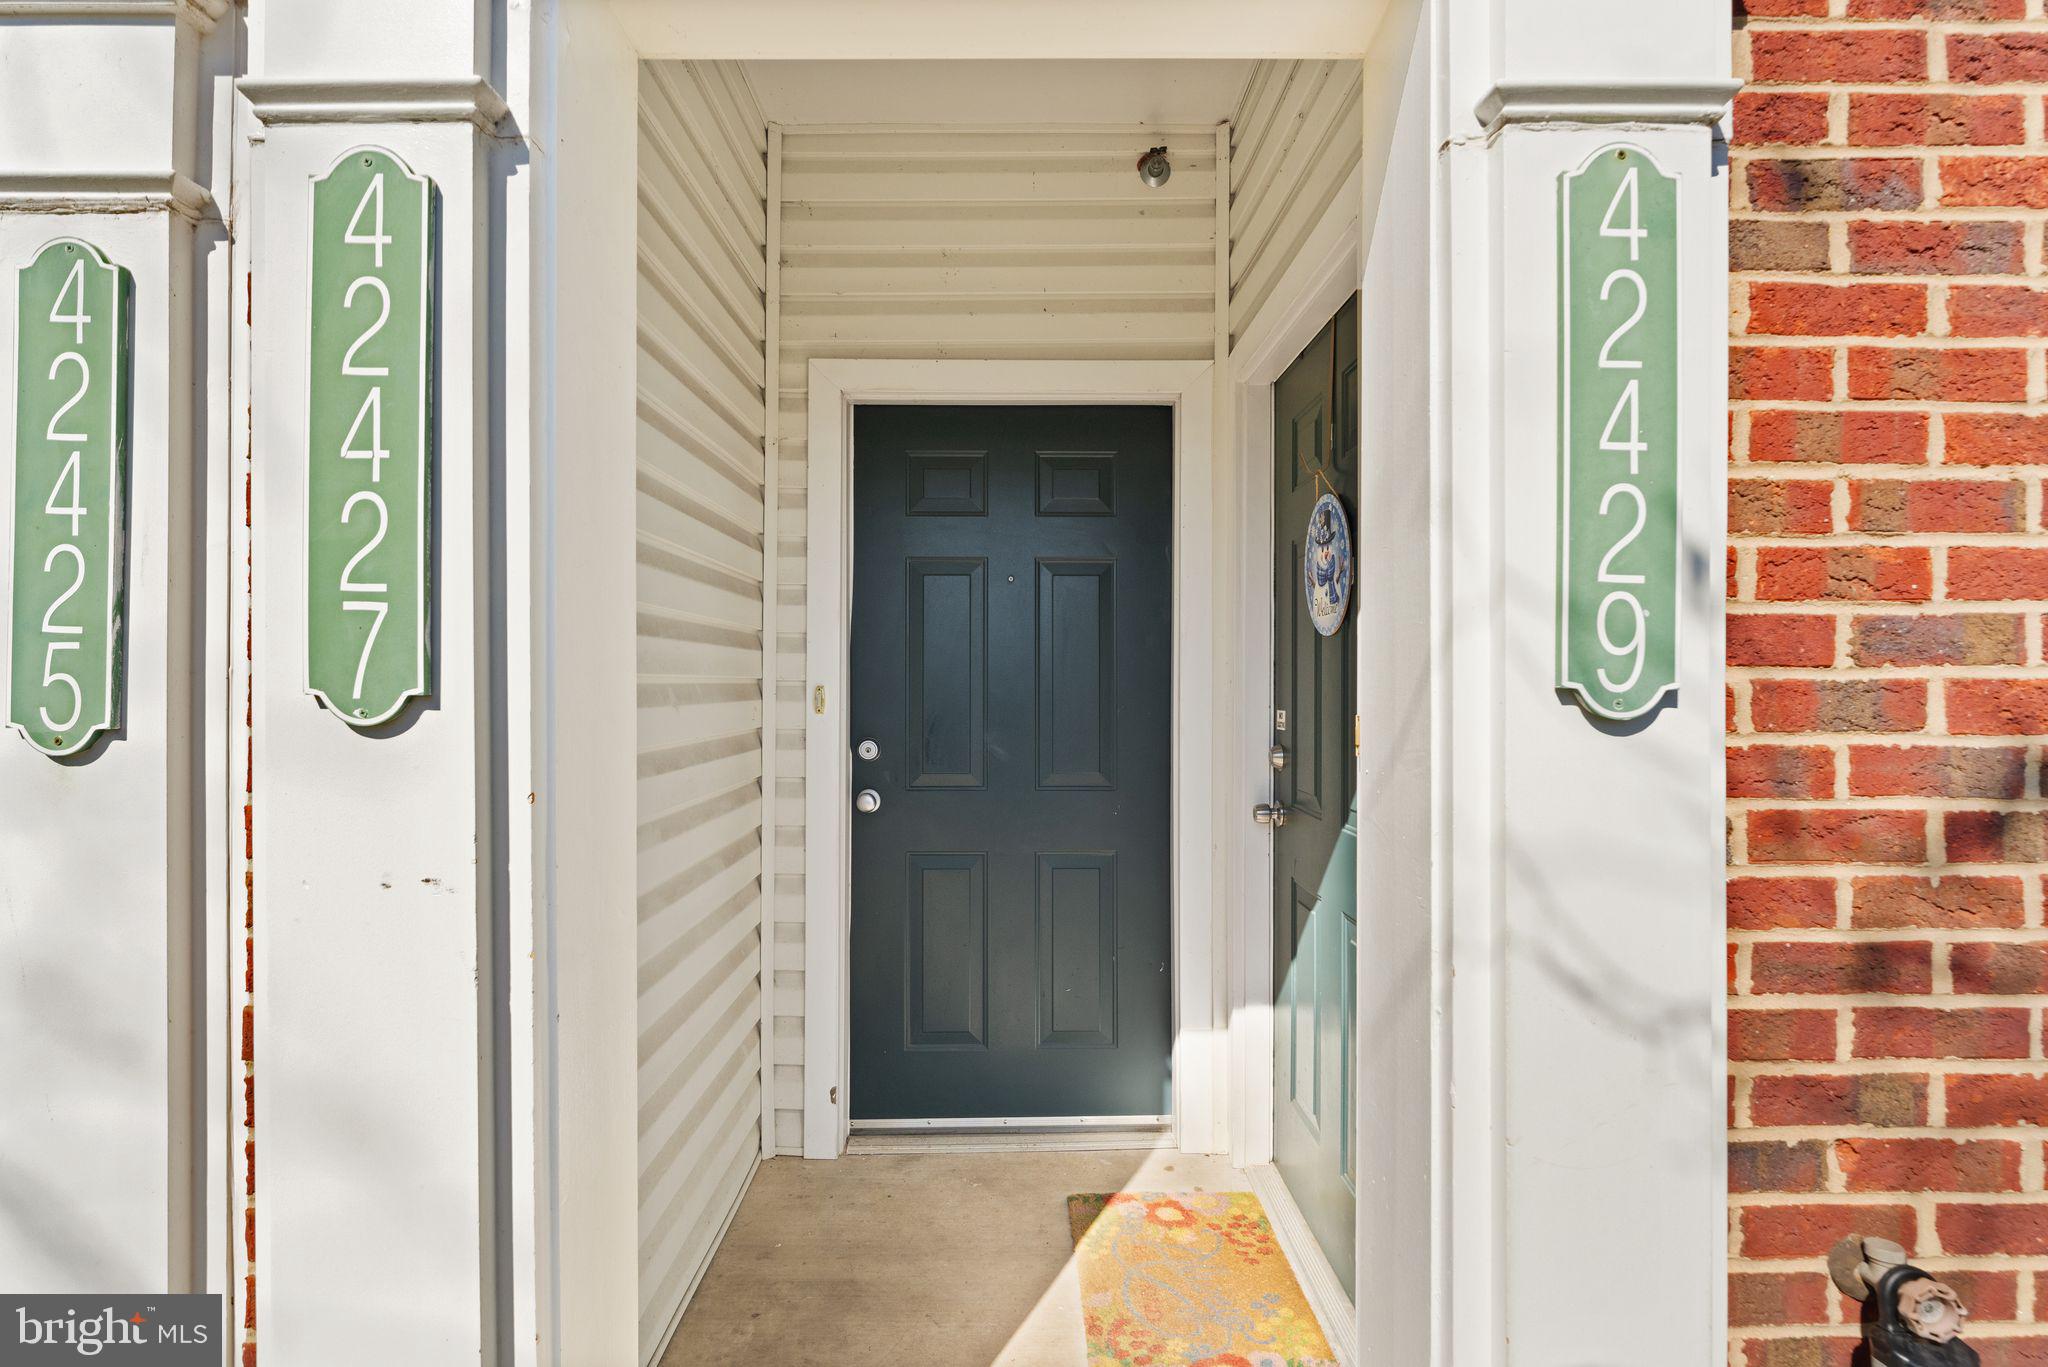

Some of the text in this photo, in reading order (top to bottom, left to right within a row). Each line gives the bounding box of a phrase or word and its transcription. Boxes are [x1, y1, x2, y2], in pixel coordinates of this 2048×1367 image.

[39, 258, 92, 733] 42425
[339, 172, 393, 700] 42427
[1596, 166, 1648, 694] 42429
